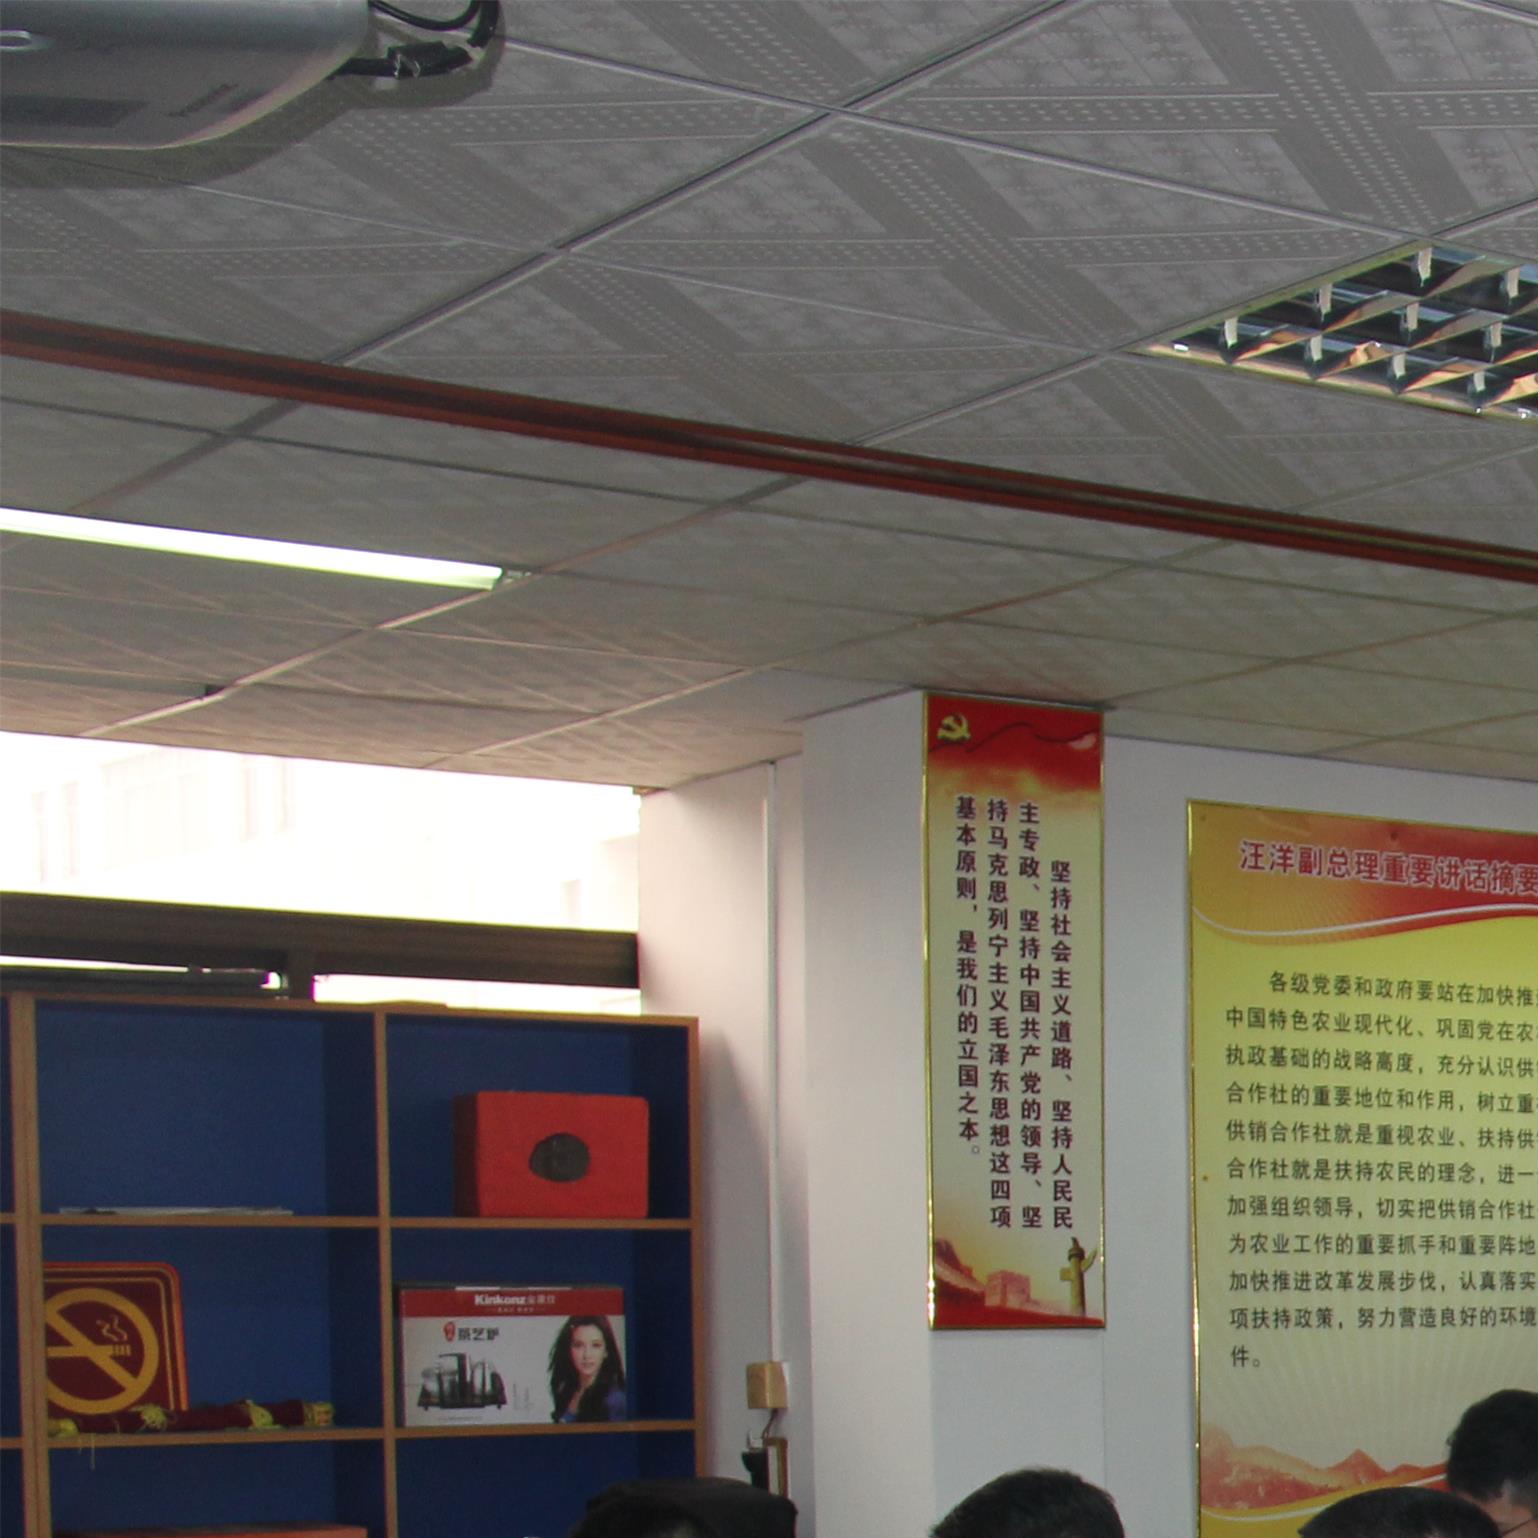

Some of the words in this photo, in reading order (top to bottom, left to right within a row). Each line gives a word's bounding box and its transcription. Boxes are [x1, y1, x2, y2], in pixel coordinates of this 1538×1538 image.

[956, 796, 980, 1154] 基本原则，是我们的立国之本。
[988, 798, 1011, 1228] 持马克思列宁主义毛泽东思想这四项
[1019, 802, 1042, 1228] 主专政、坚持中国共产党的领导、坚
[1050, 861, 1073, 1229] 坚持社会主义道路、坚持人民民
[1231, 1346, 1261, 1368] 件。
